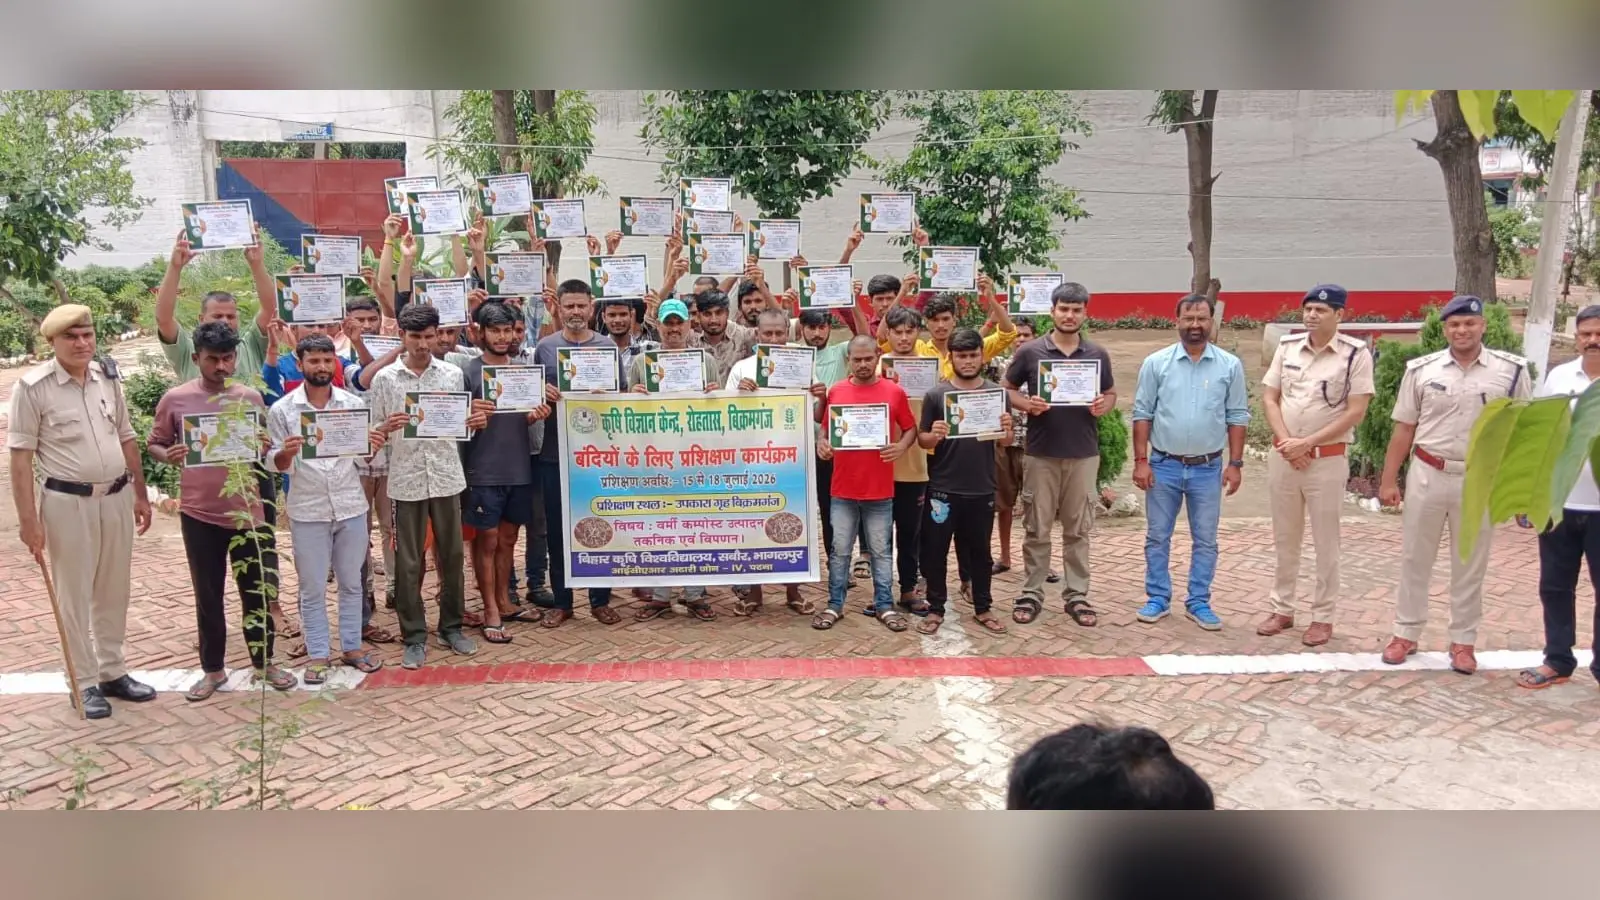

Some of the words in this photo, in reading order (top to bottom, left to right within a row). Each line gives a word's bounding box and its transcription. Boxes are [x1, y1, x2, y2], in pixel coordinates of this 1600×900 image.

[600, 406, 622, 440] कृषि
[624, 407, 656, 434] विज्ञान
[658, 405, 684, 437] केन्द्र,
[686, 405, 725, 436] रोहतास,
[574, 444, 620, 468] बंदियों
[624, 445, 640, 468] के
[644, 445, 674, 469] लिए
[679, 444, 736, 467] प्रशिक्षण
[740, 440, 797, 464] कार्यक्रम
[600, 473, 638, 488] प्रशिक्षण
[683, 476, 693, 486] 15
[695, 471, 704, 485] से
[709, 475, 720, 485] 18
[722, 470, 749, 488] जुलाई
[752, 473, 776, 485] 2026
[596, 498, 634, 512] प्रशिक्षण
[713, 499, 730, 511] गृह
[613, 519, 645, 532] विषय
[656, 517, 678, 530] वर्मी
[682, 516, 723, 529] कम्पोस्ट
[726, 518, 765, 530] उत्पादन
[633, 533, 676, 546] तकनिक
[678, 532, 696, 547] एवं
[577, 552, 609, 565] बिहार
[611, 551, 638, 568] कृषि
[640, 550, 716, 565] विश्वविद्यालय,
[753, 549, 804, 564] भागलपुर
